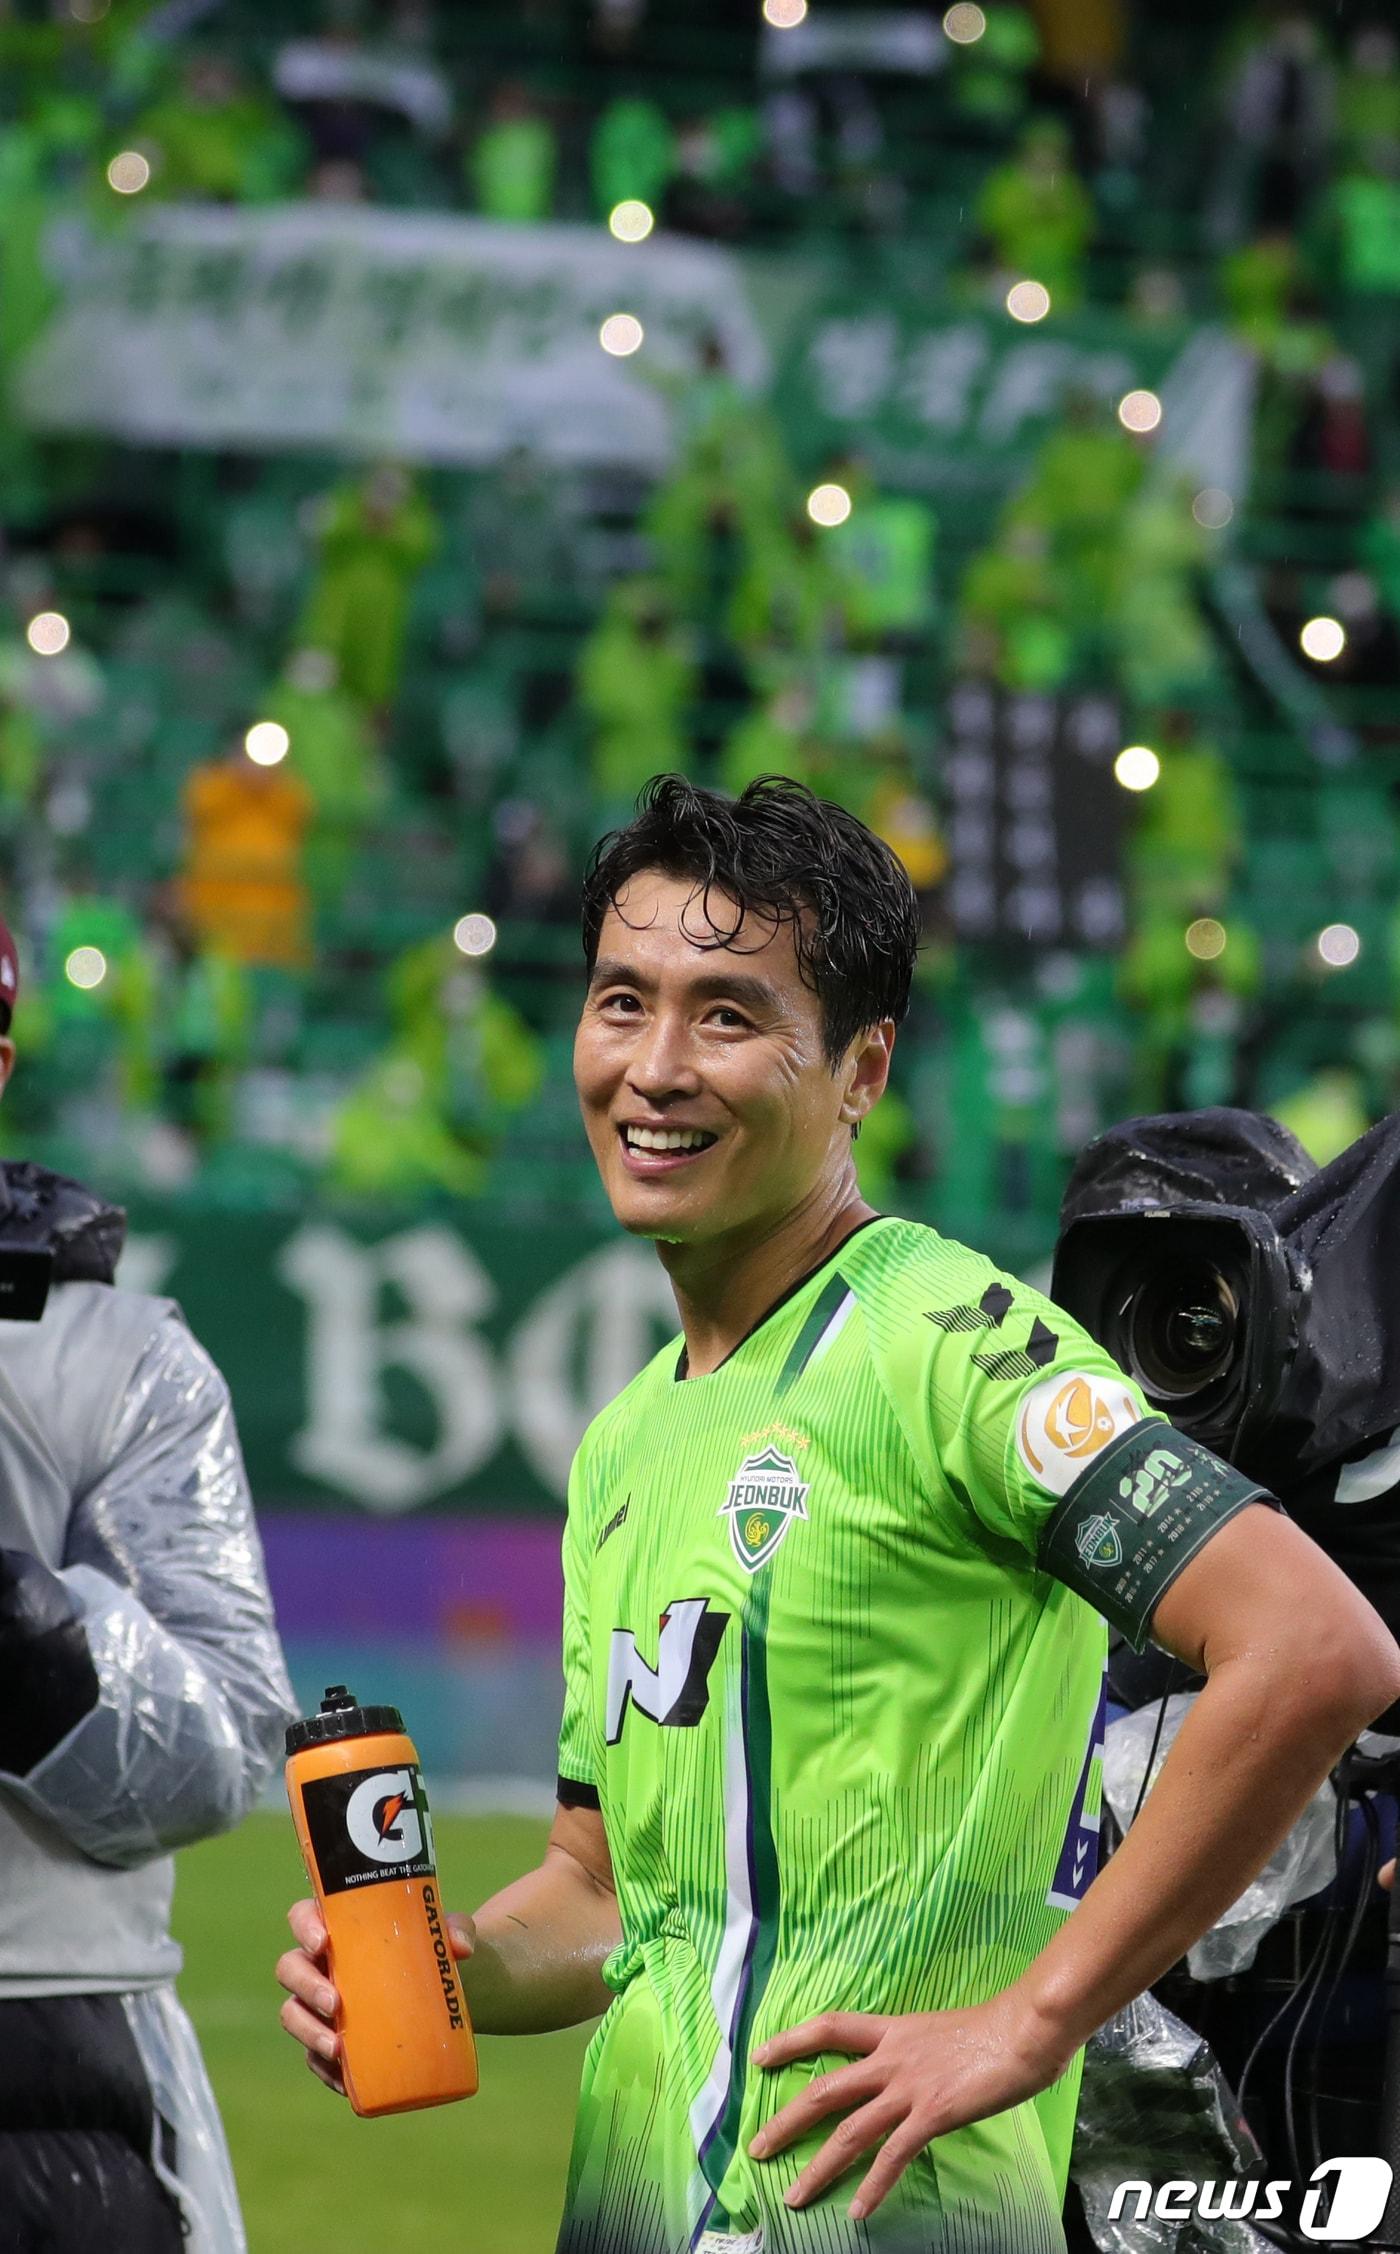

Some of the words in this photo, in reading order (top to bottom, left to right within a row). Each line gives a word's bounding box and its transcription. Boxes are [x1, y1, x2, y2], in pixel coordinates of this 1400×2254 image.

[723, 1485, 806, 1515] JEONBUK
[1133, 1547, 1147, 1565] 2011
[1158, 1515, 1174, 1533] 2014
[1143, 1556, 1158, 1574] 2017
[1168, 1524, 1184, 1542] 2018
[346, 1769, 423, 1863] G
[345, 1870, 379, 1885] NOTHING
[380, 1867, 397, 1878] BEAT
[399, 1865, 412, 1874] THE
[422, 1885, 463, 2030] GATORADE
